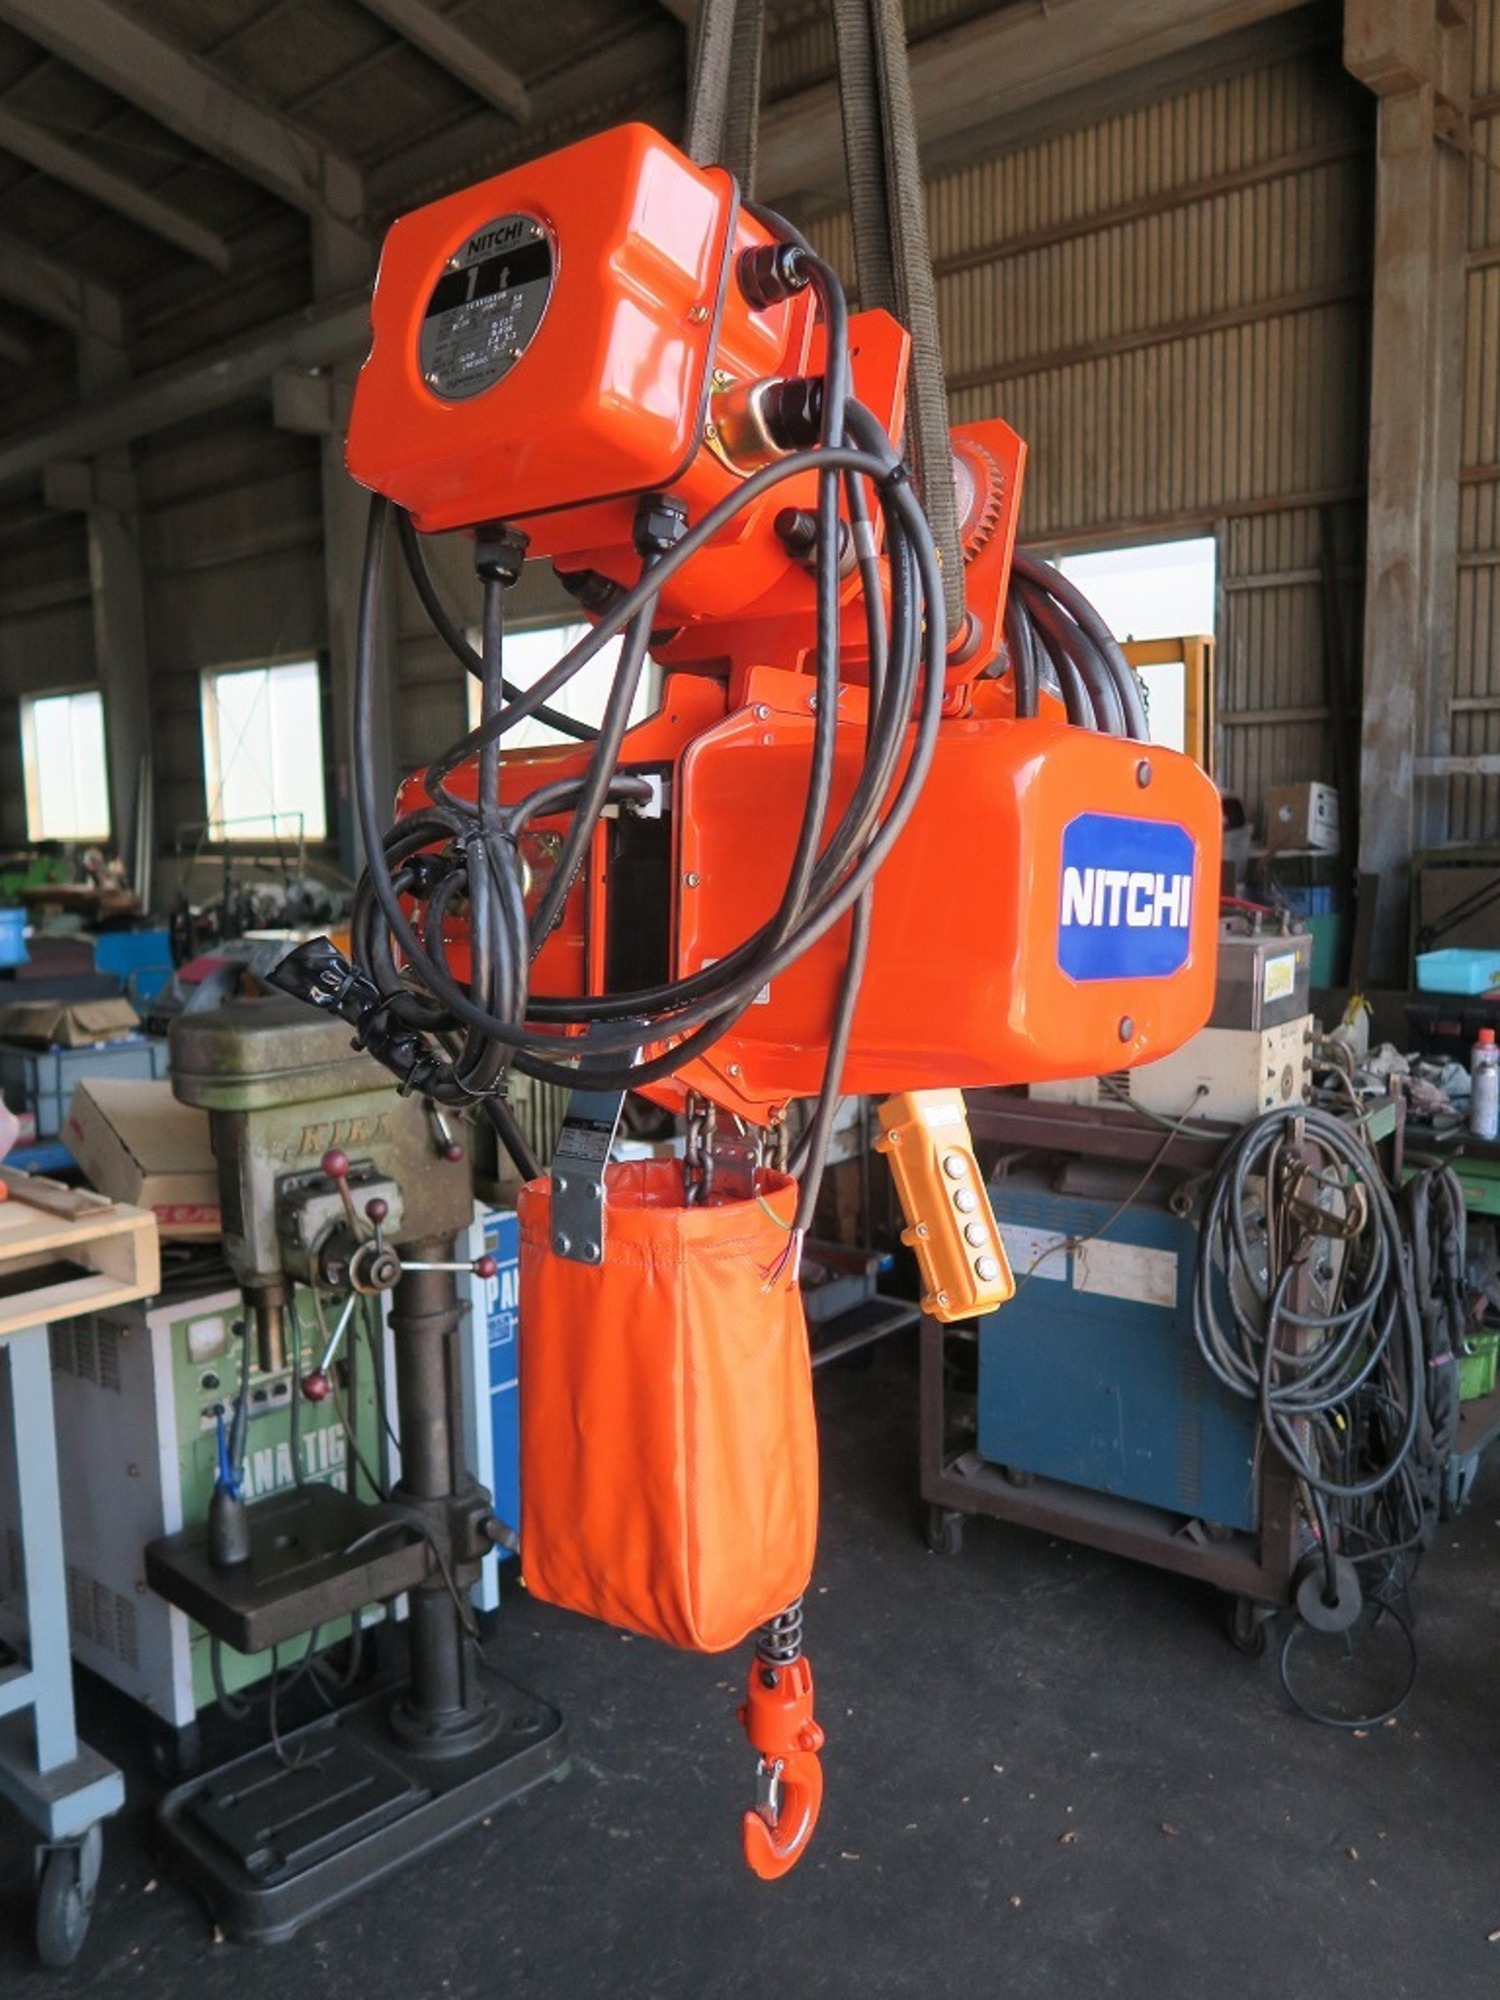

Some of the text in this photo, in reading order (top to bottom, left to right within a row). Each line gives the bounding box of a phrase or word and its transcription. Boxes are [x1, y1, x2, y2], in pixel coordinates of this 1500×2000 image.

[467, 221, 523, 256] NITCHI
[466, 266, 479, 301] 1
[499, 266, 510, 290] t
[1061, 866, 1192, 927] NITCHI
